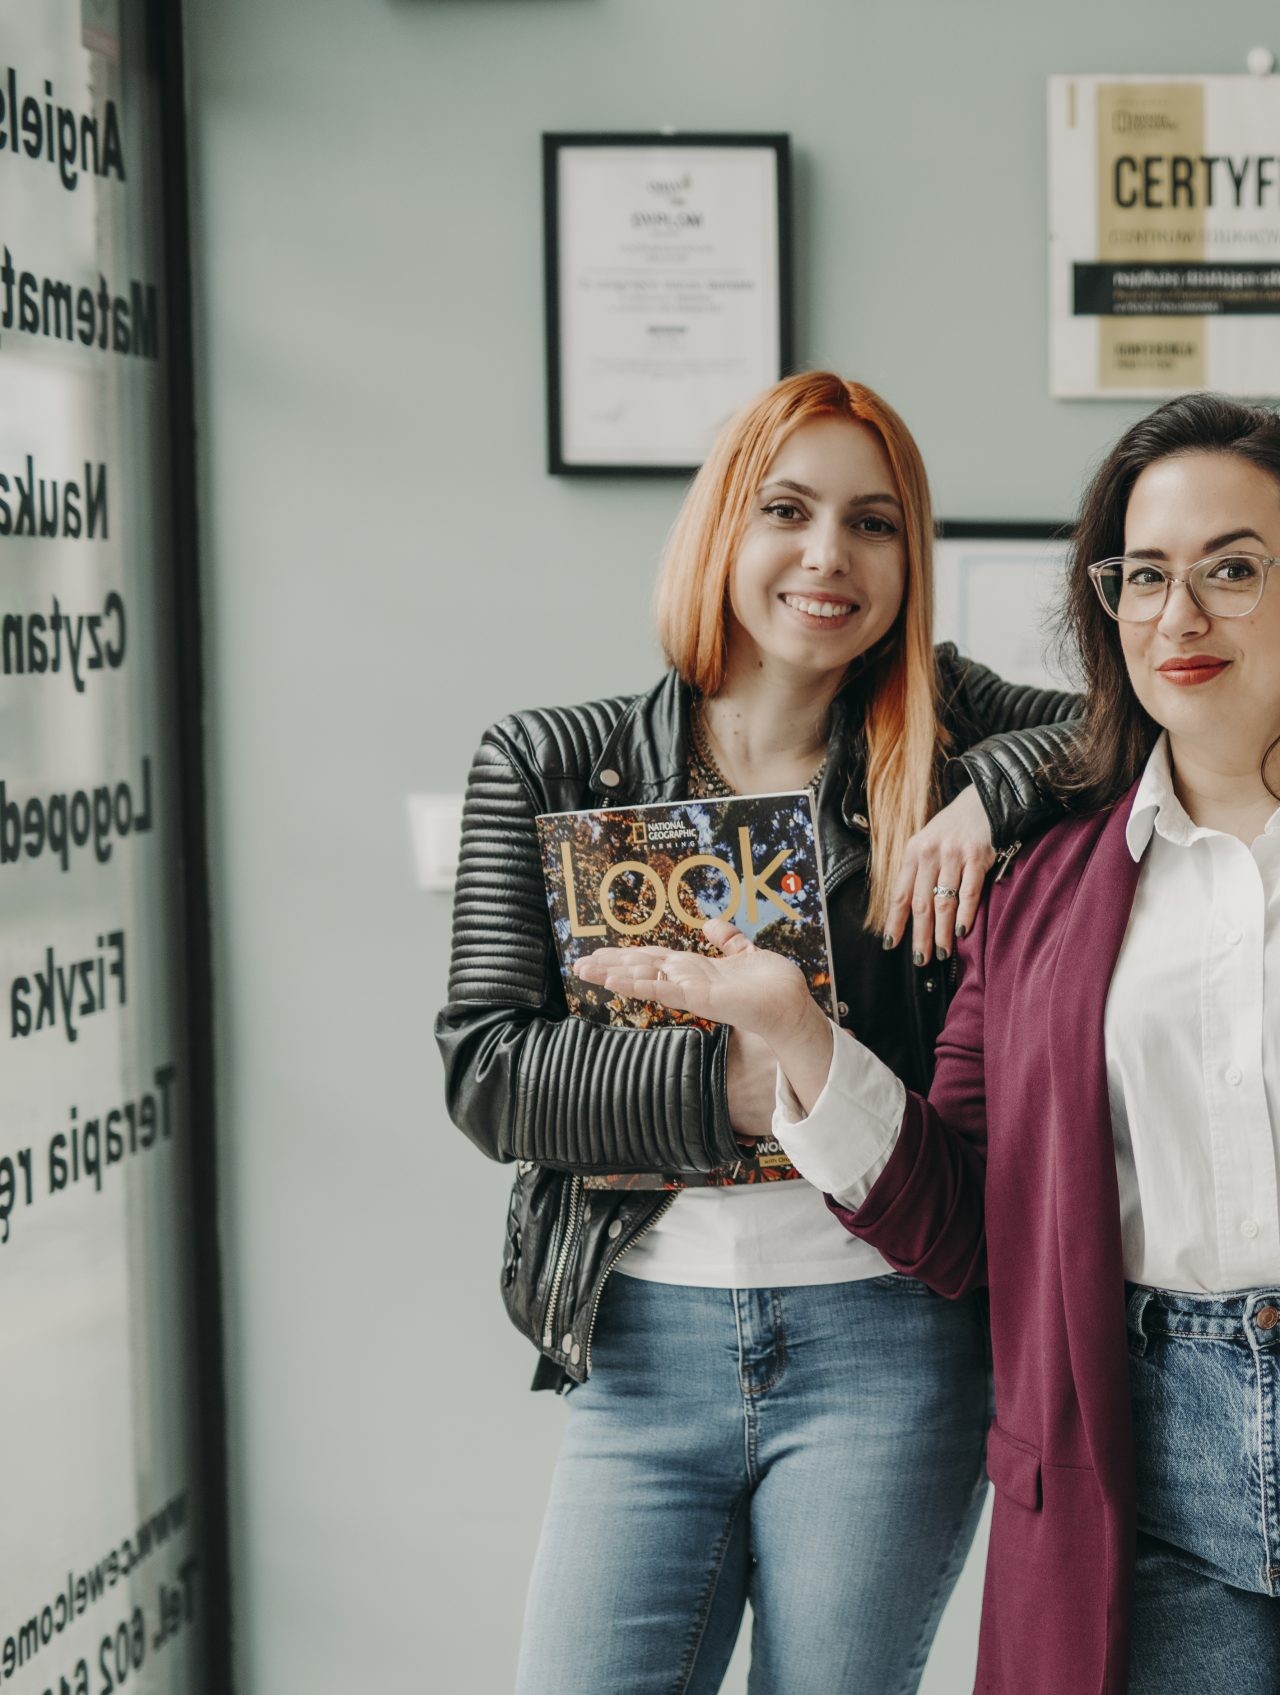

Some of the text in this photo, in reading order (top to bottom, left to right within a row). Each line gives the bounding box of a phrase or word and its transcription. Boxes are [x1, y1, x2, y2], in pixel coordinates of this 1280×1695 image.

[647, 820, 686, 833] NATIONAL
[648, 828, 698, 842] GEOGRAPHIC
[560, 826, 802, 938] Look
